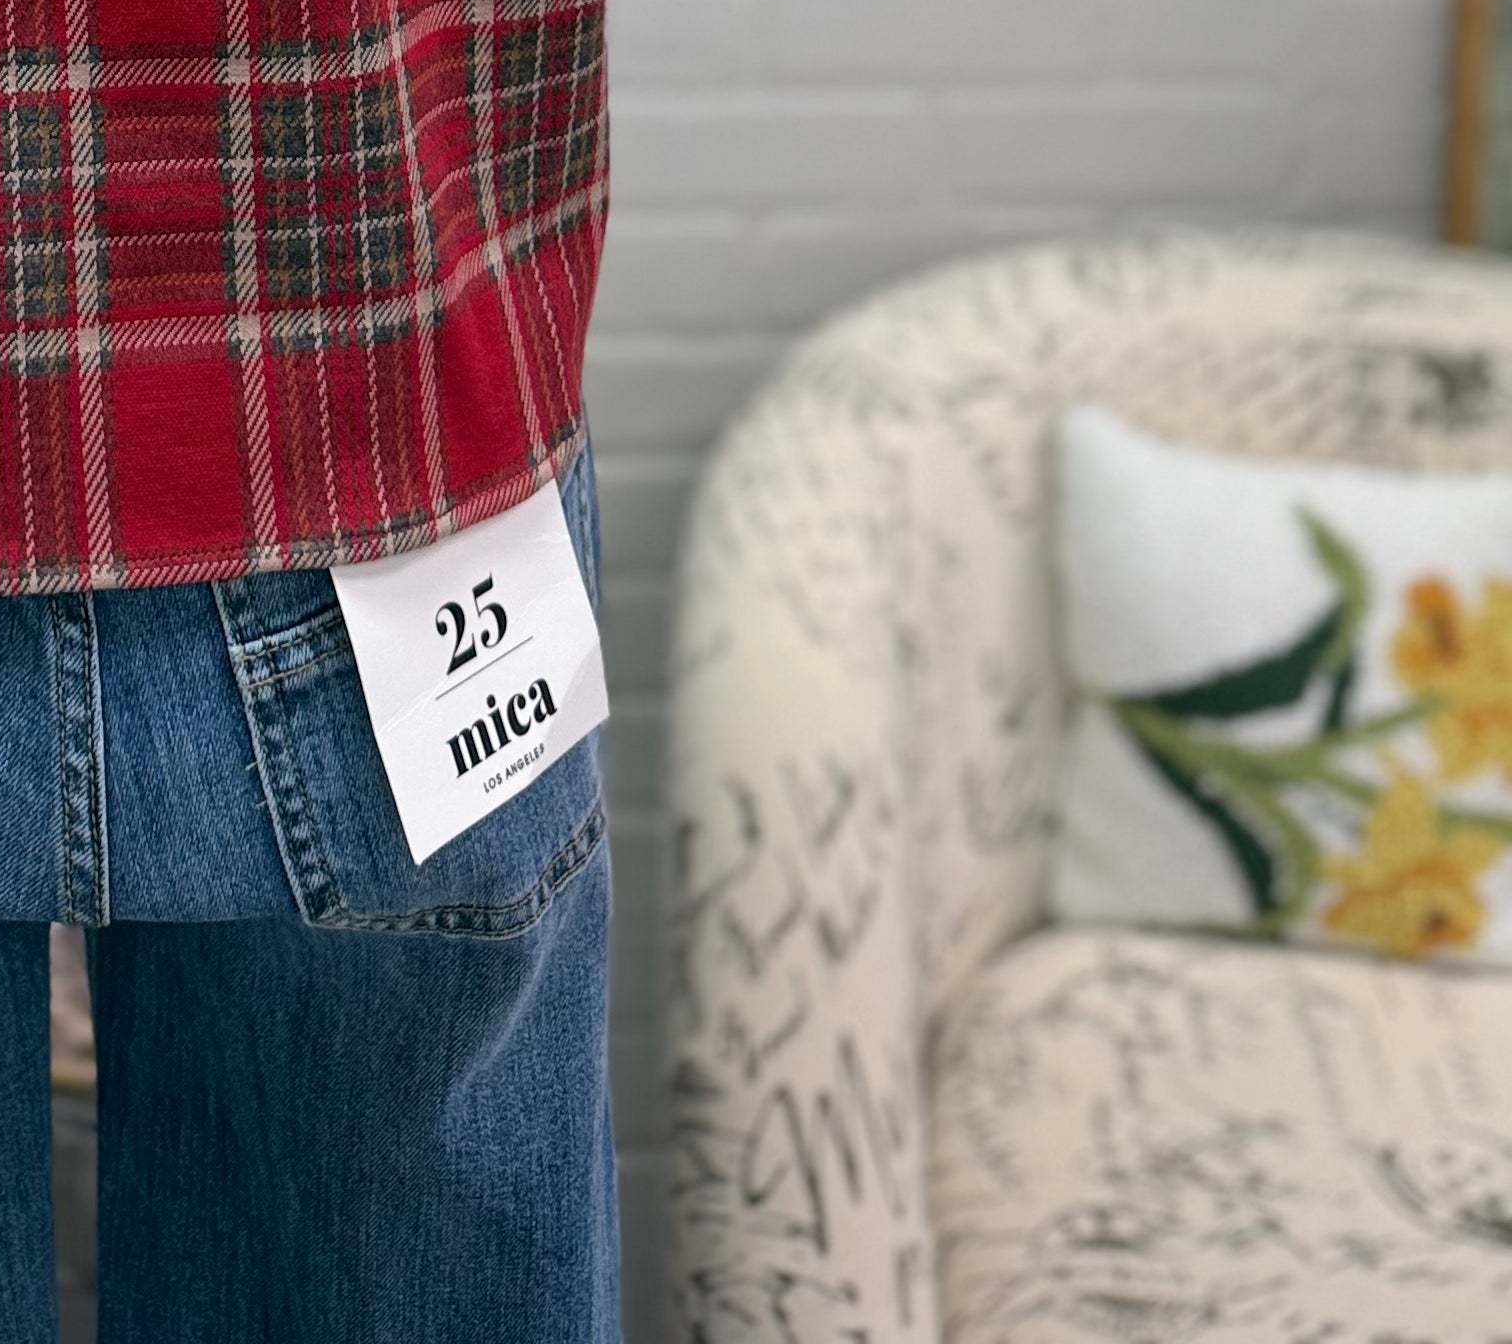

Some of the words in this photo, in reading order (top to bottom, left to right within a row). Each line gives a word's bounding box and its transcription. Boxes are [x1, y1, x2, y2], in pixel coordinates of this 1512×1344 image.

[435, 572, 508, 675] 25
[445, 677, 558, 778] mica
[483, 773, 503, 794] LOS
[504, 742, 546, 780] ANGELES
